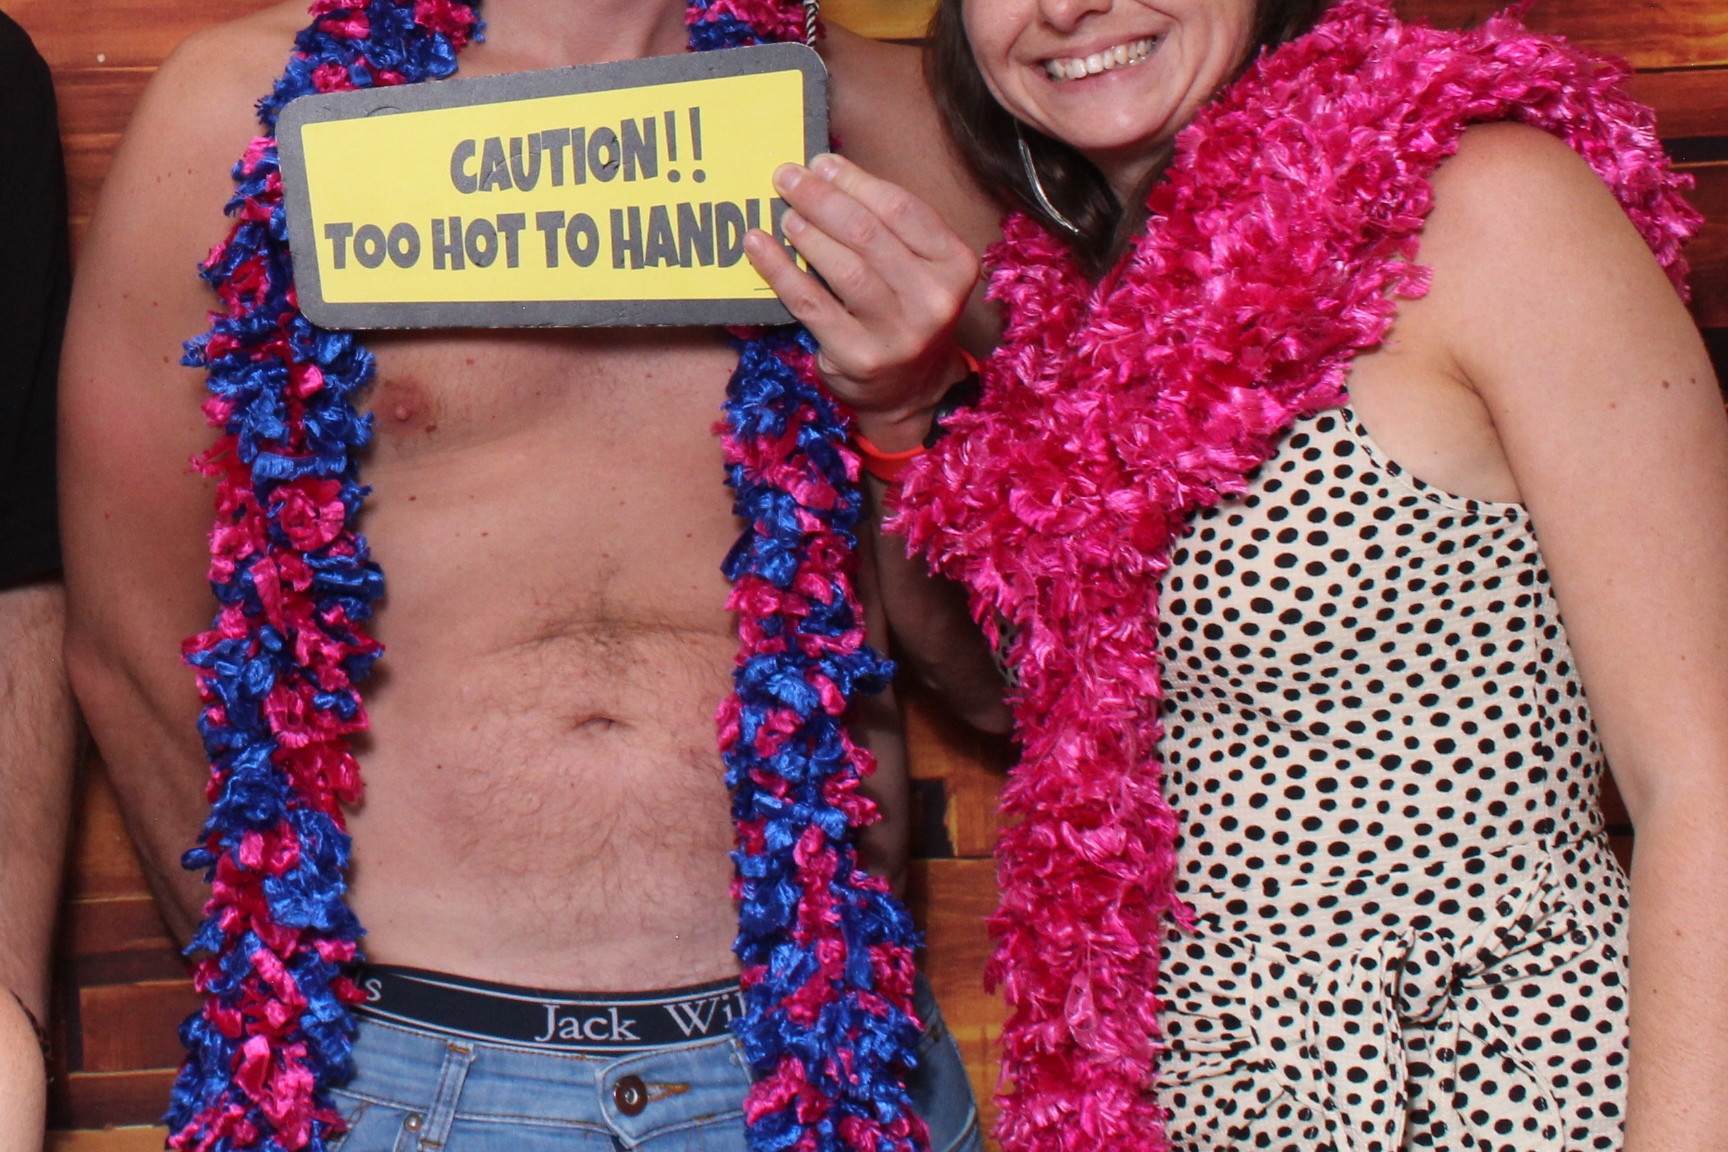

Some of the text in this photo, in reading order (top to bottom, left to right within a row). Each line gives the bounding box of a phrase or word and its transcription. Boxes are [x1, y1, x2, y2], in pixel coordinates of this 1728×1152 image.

[450, 107, 707, 194] CAUTION!!
[324, 222, 421, 270] TOO
[431, 213, 526, 271] HOT
[536, 211, 600, 268] TO
[535, 1004, 641, 1044] Jack
